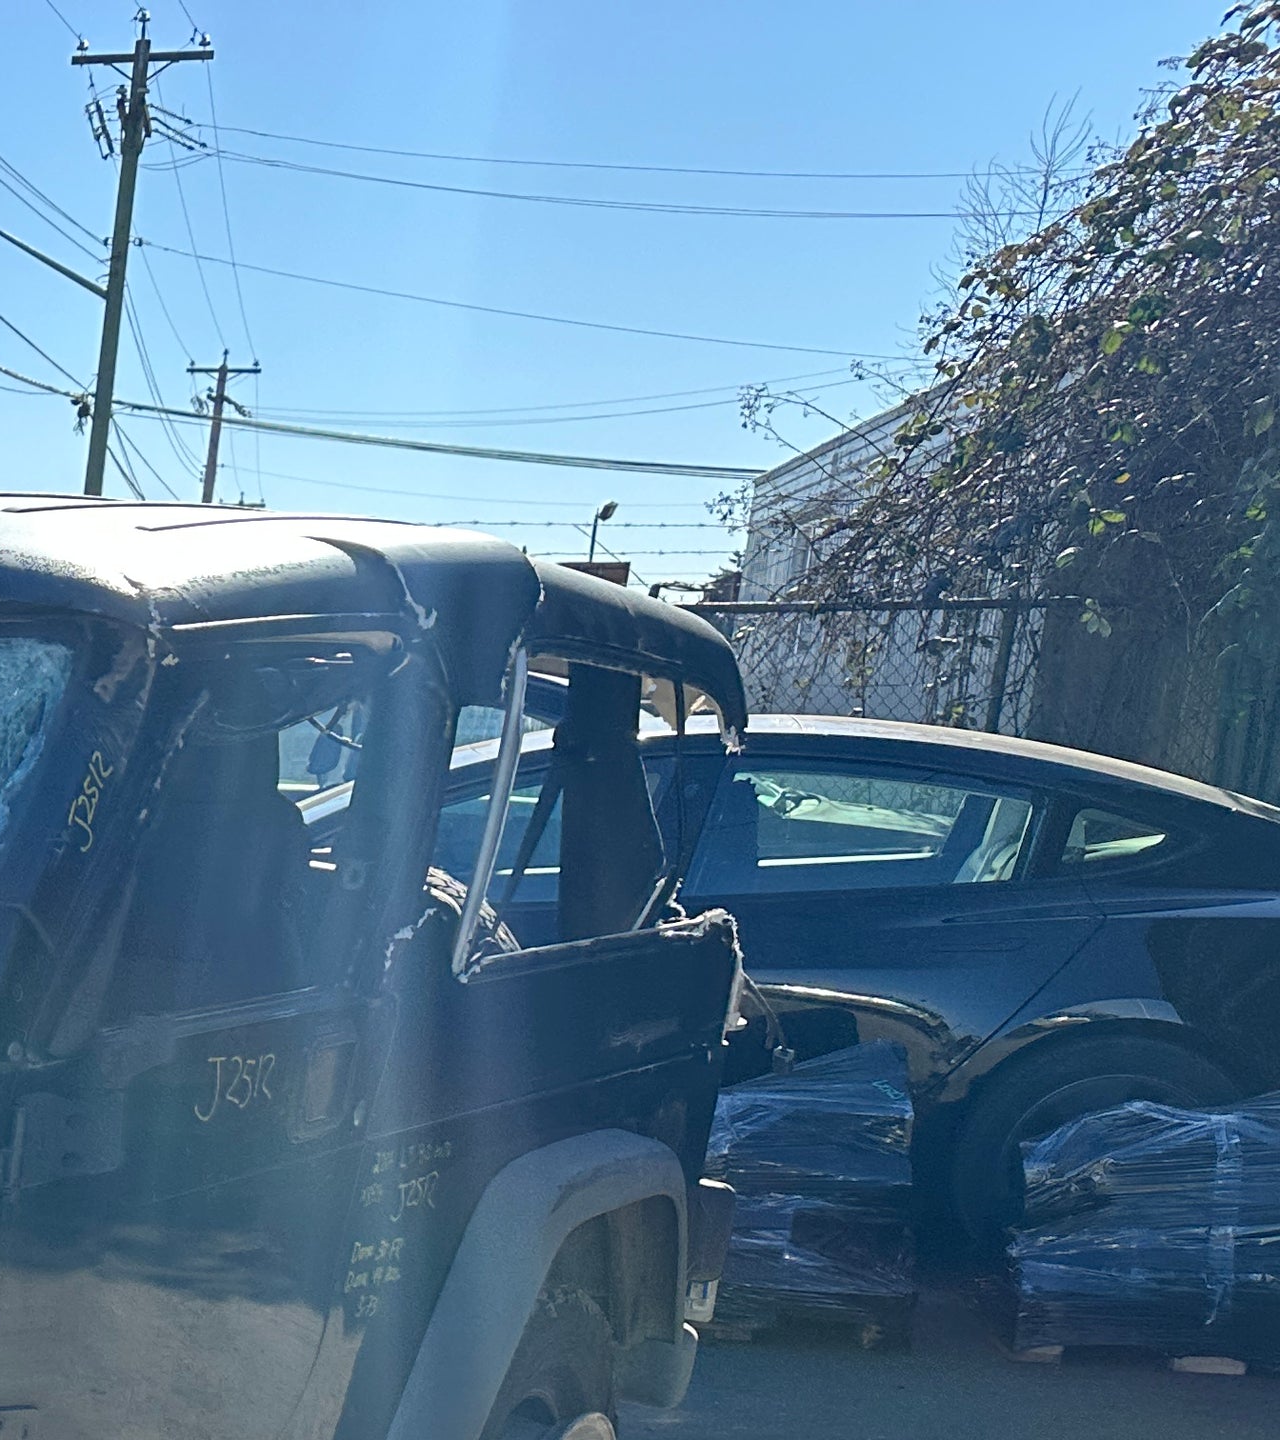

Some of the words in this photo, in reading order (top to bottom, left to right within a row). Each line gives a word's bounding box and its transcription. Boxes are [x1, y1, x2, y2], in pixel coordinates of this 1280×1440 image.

[68, 750, 114, 853] J2512
[194, 1053, 276, 1122] J2512
[389, 1170, 441, 1223] J2512
